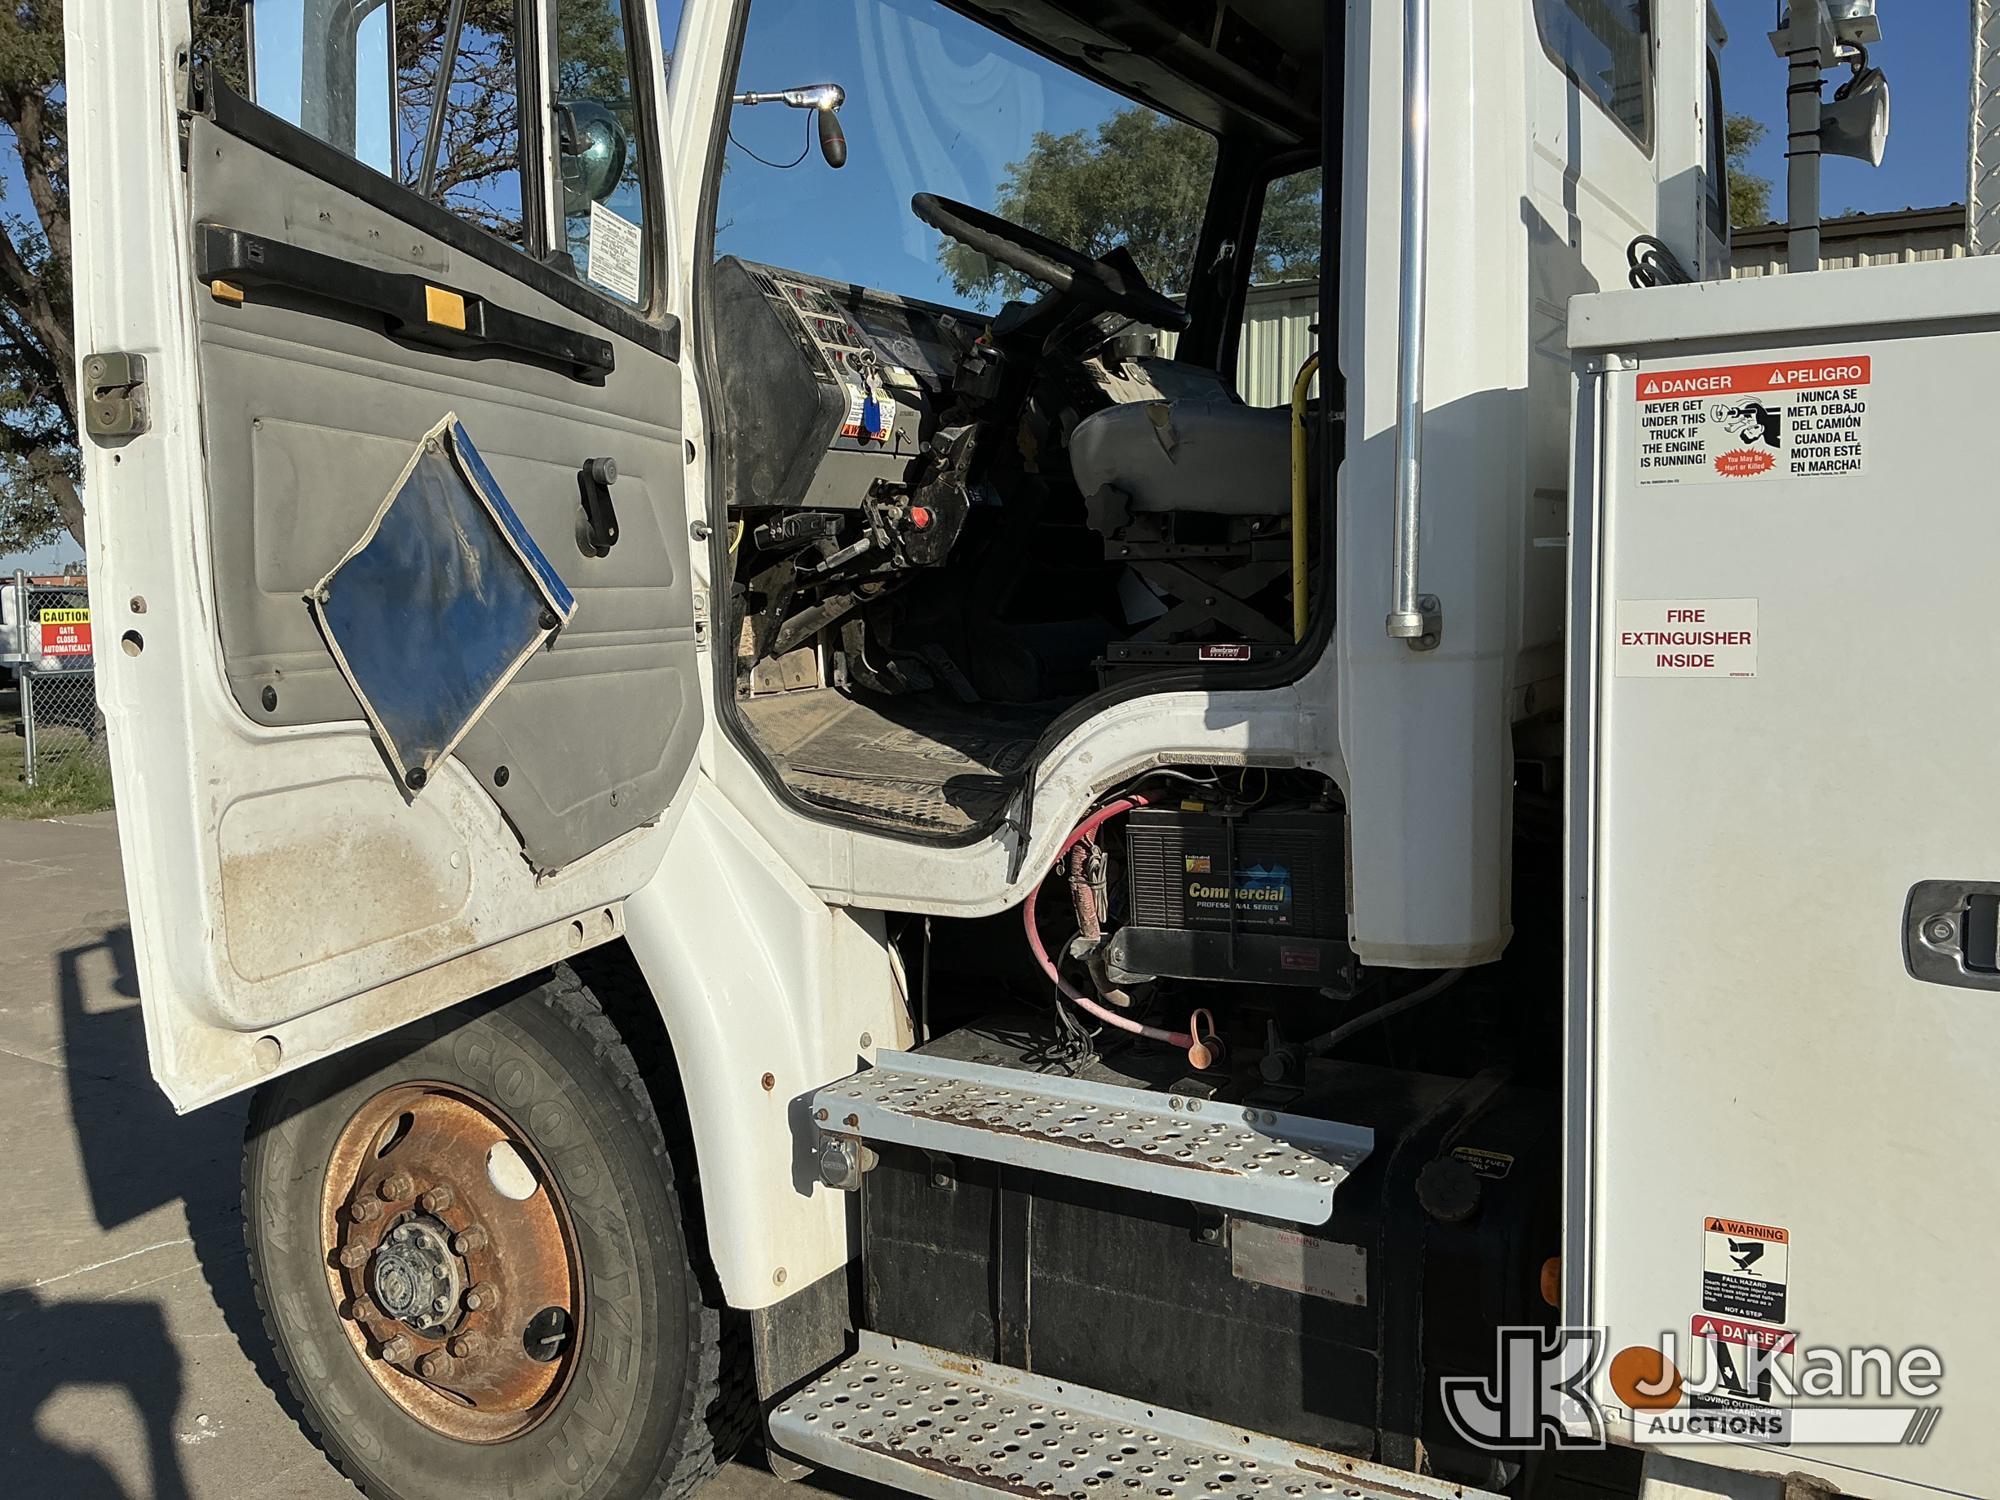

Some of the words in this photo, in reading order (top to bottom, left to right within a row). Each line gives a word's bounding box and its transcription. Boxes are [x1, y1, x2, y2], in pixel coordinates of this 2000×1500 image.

[1787, 365, 1862, 384] PELIGRO
[1661, 375, 1732, 393] DANGER
[1843, 389, 1858, 400] SE
[1644, 401, 1681, 414] NEVER
[1683, 400, 1704, 411] GET
[1787, 405, 1819, 418] META
[1821, 402, 1866, 415] DEBAJO
[1641, 415, 1679, 428] UNDER
[1681, 413, 1706, 425] THIS
[1792, 420, 1813, 431] DEL
[1816, 415, 1861, 430] CAMIÓN
[1650, 428, 1686, 441] TRUCK
[1689, 427, 1698, 438] IF
[1795, 433, 1841, 445] CUANDA
[1844, 431, 1858, 442] EL
[1642, 443, 1663, 455] THE
[1665, 441, 1705, 453] ENGINE
[1790, 447, 1831, 459] MOTOR
[1834, 443, 1862, 456] ESTÉ
[1640, 457, 1652, 468] IS
[1654, 454, 1706, 467] RUNNING!
[1739, 455, 1753, 463] May
[1754, 454, 1763, 462] Be
[1790, 461, 1805, 473] EN
[1808, 458, 1861, 472] MARCHA!
[1747, 462, 1765, 470] Killed
[43, 611, 89, 622] CAUTION
[1667, 609, 1705, 623] FIRE
[59, 626, 74, 634] GATE
[56, 635, 78, 644] CLOSES
[1621, 631, 1752, 645] EXTINGUISHER
[44, 644, 91, 653] AUTOMATICALLY
[1656, 654, 1715, 667] INSIDE
[1252, 903, 1279, 911] SERIES
[1727, 1222, 1783, 1241] WARNING
[1722, 1275, 1739, 1284] FALL
[1739, 1279, 1767, 1289] HAZARD
[1745, 1310, 1763, 1318] STEP
[1722, 1324, 1785, 1348] DANGER
